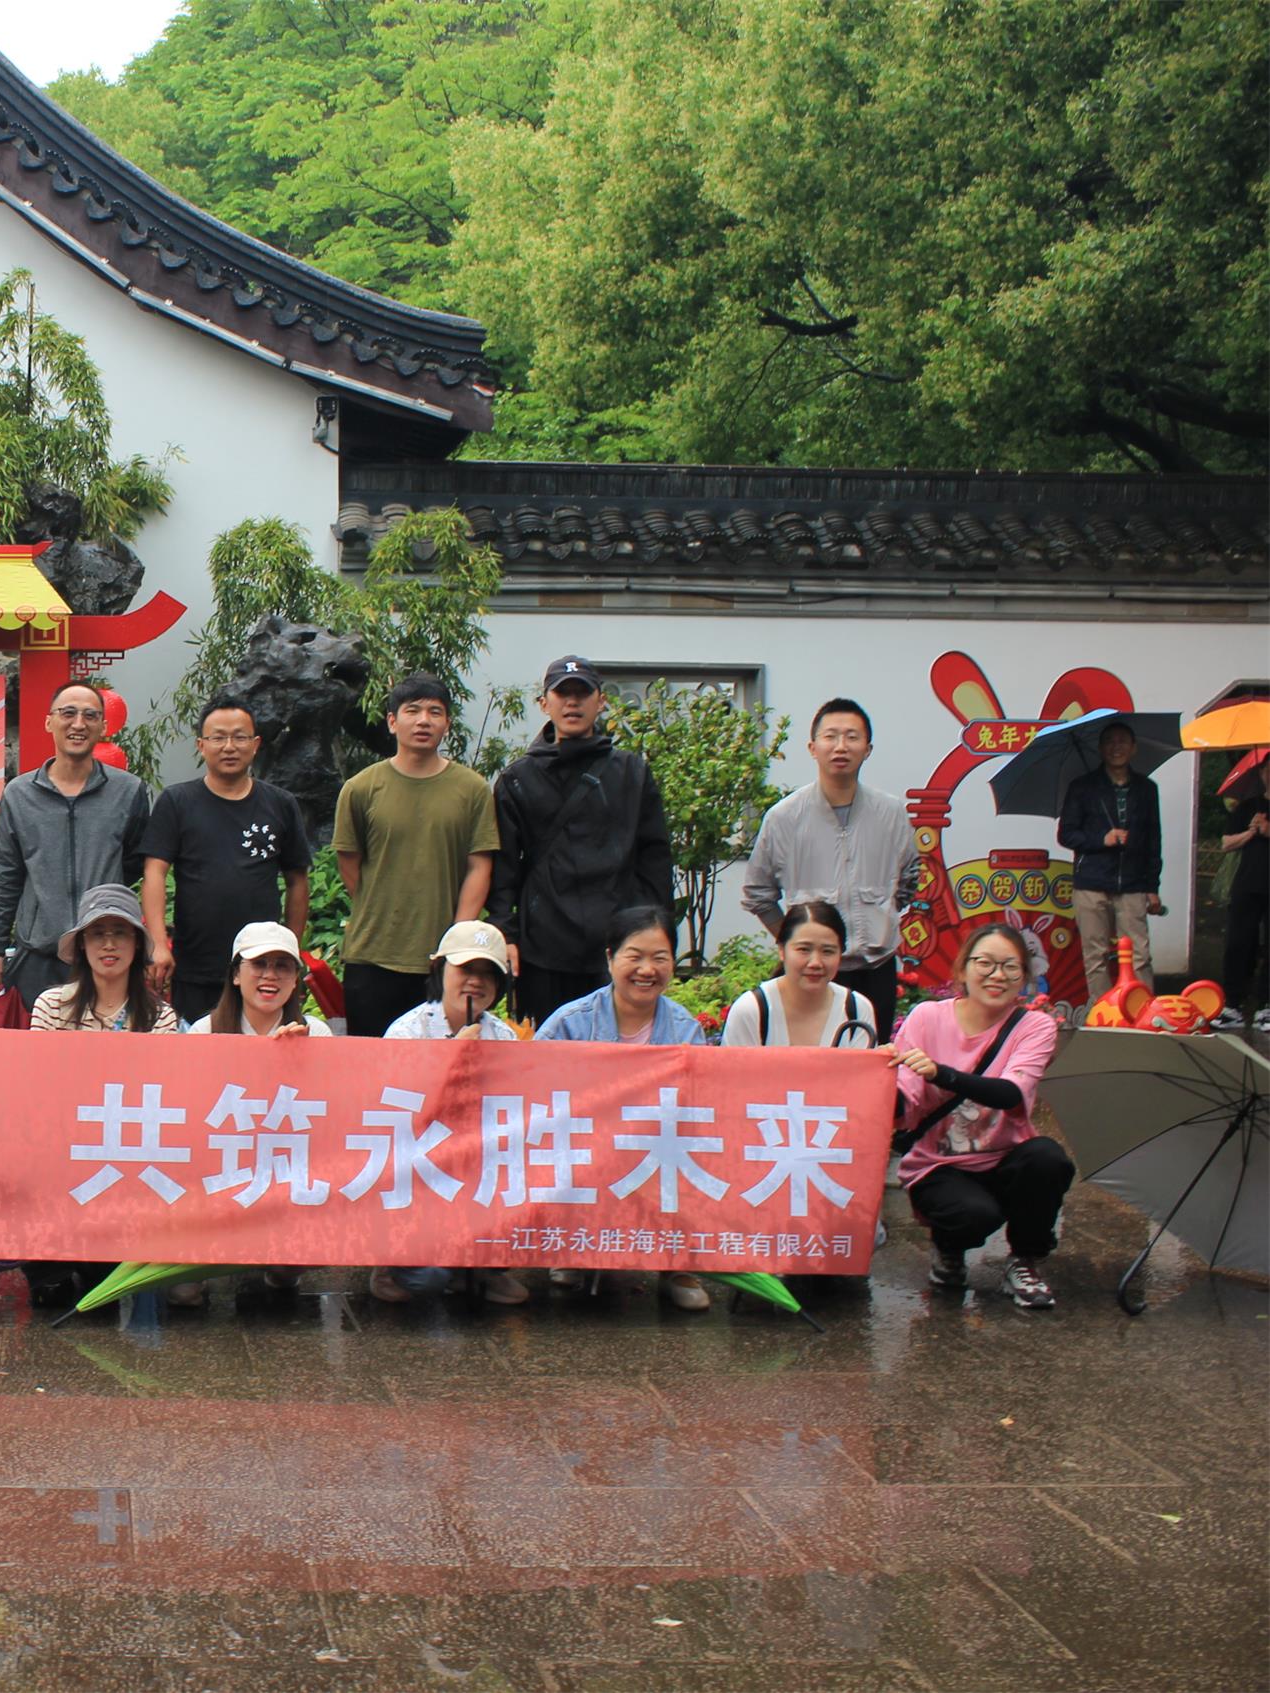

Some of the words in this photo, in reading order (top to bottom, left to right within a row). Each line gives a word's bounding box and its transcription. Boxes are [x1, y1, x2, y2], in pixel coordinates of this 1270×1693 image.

[69, 1083, 855, 1217] 共筑永胜未来
